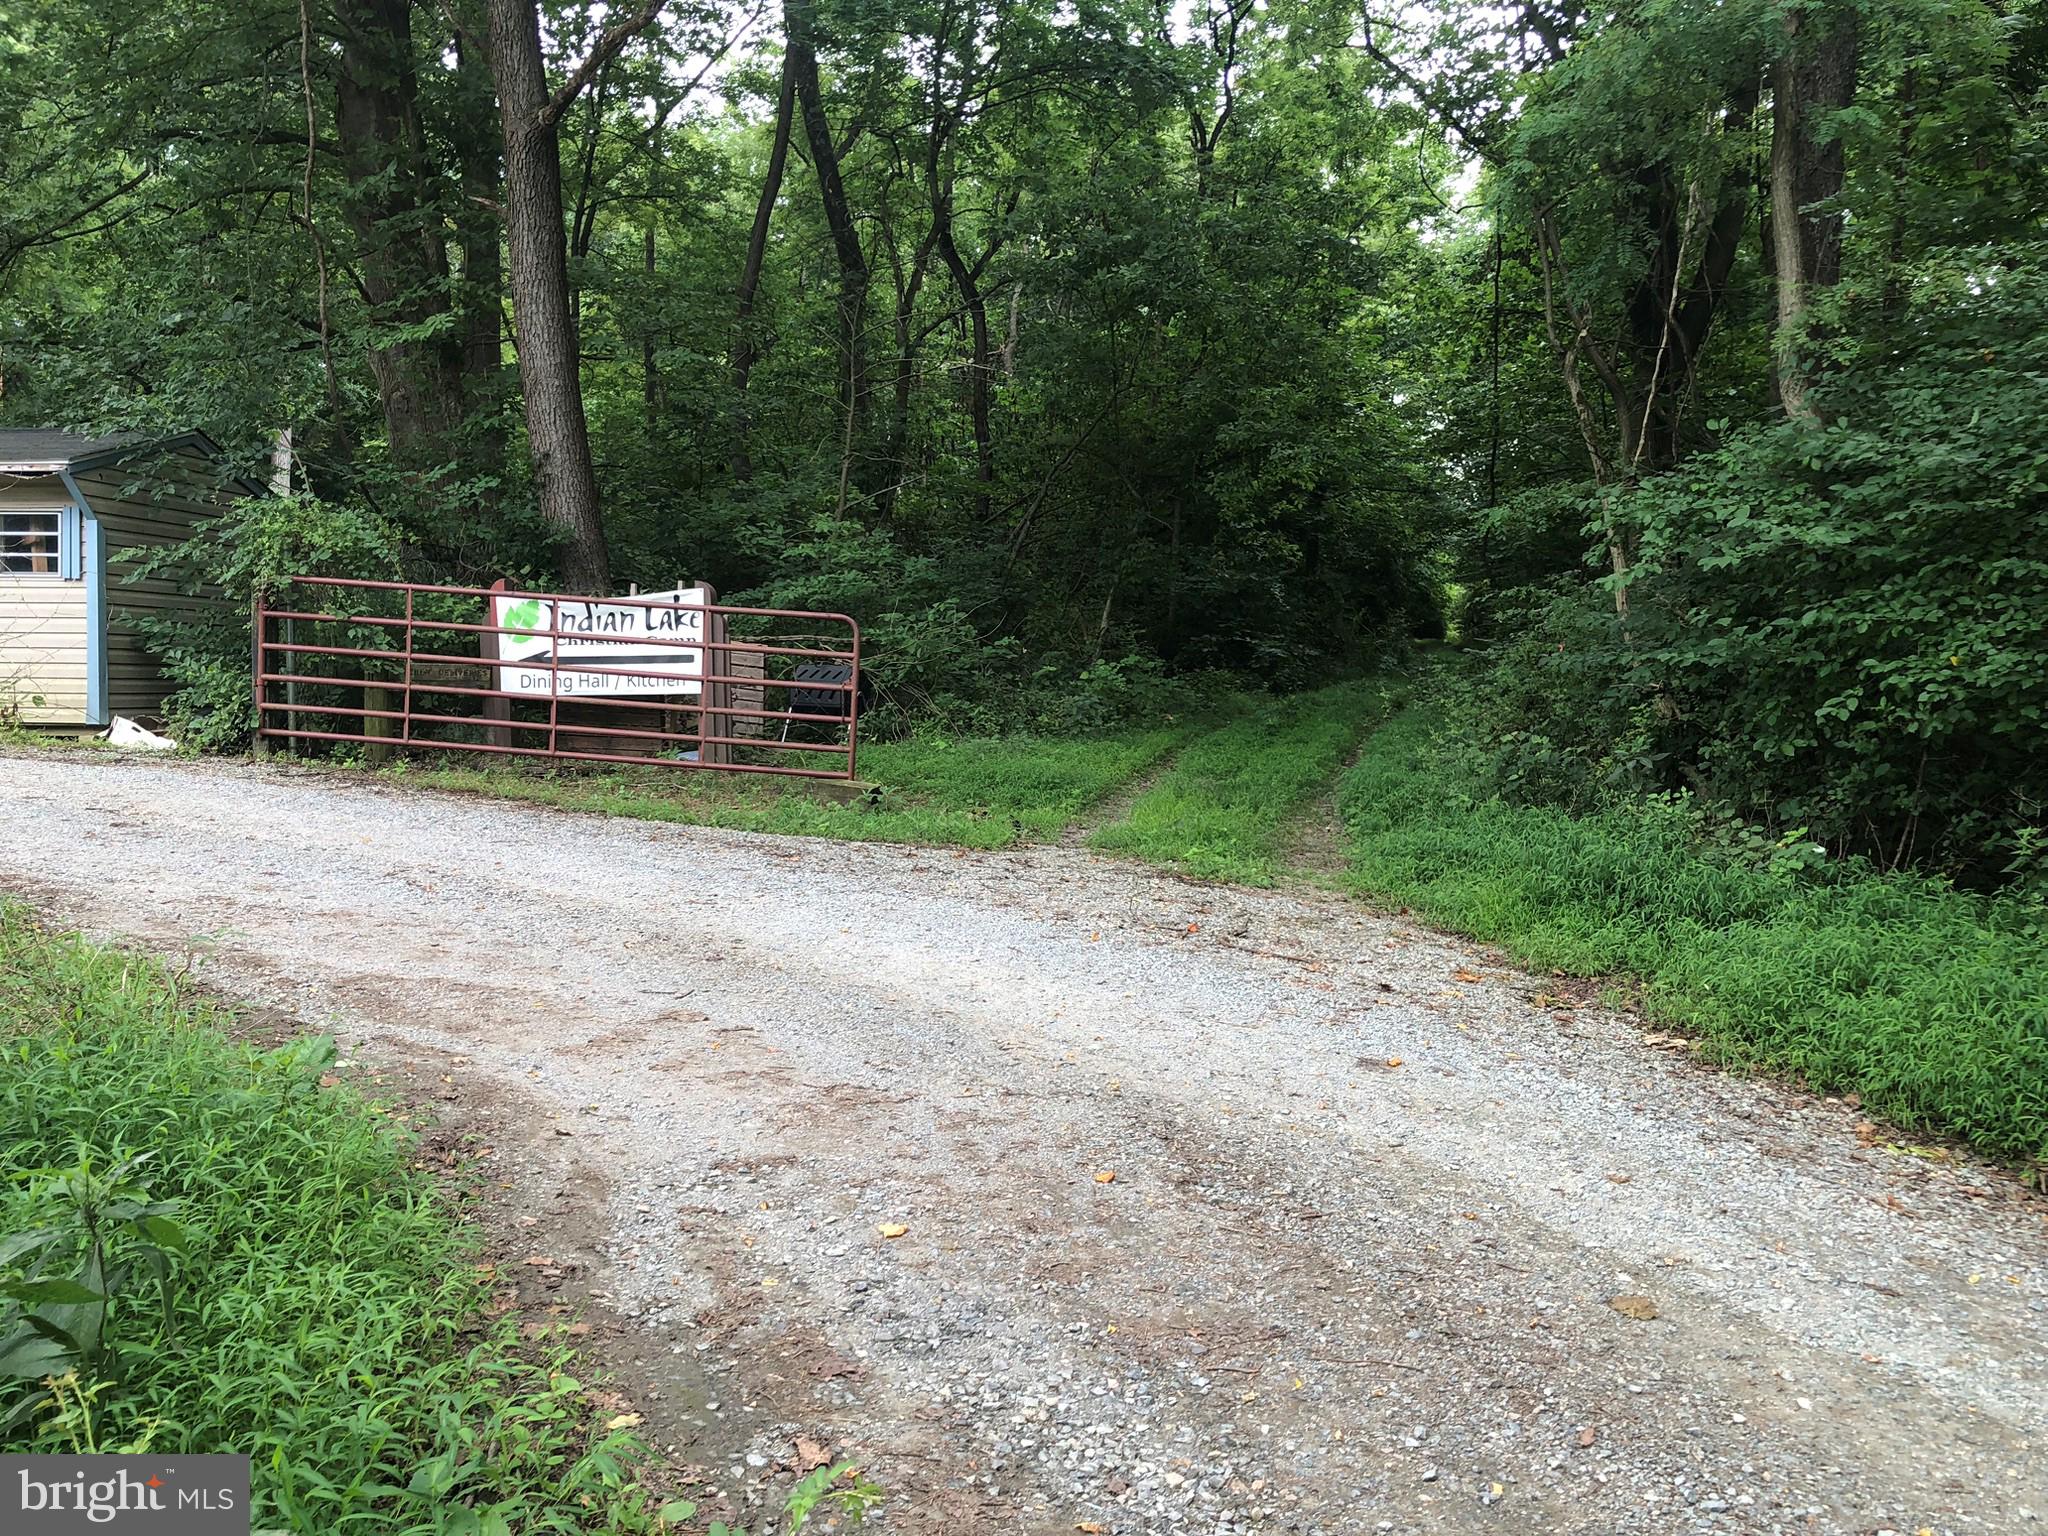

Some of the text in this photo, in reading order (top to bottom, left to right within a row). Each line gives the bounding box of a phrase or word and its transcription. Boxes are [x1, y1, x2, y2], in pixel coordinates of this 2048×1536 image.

[545, 594, 700, 633] Indian Lake
[520, 673, 687, 692] Dining Hall / Kitchen
